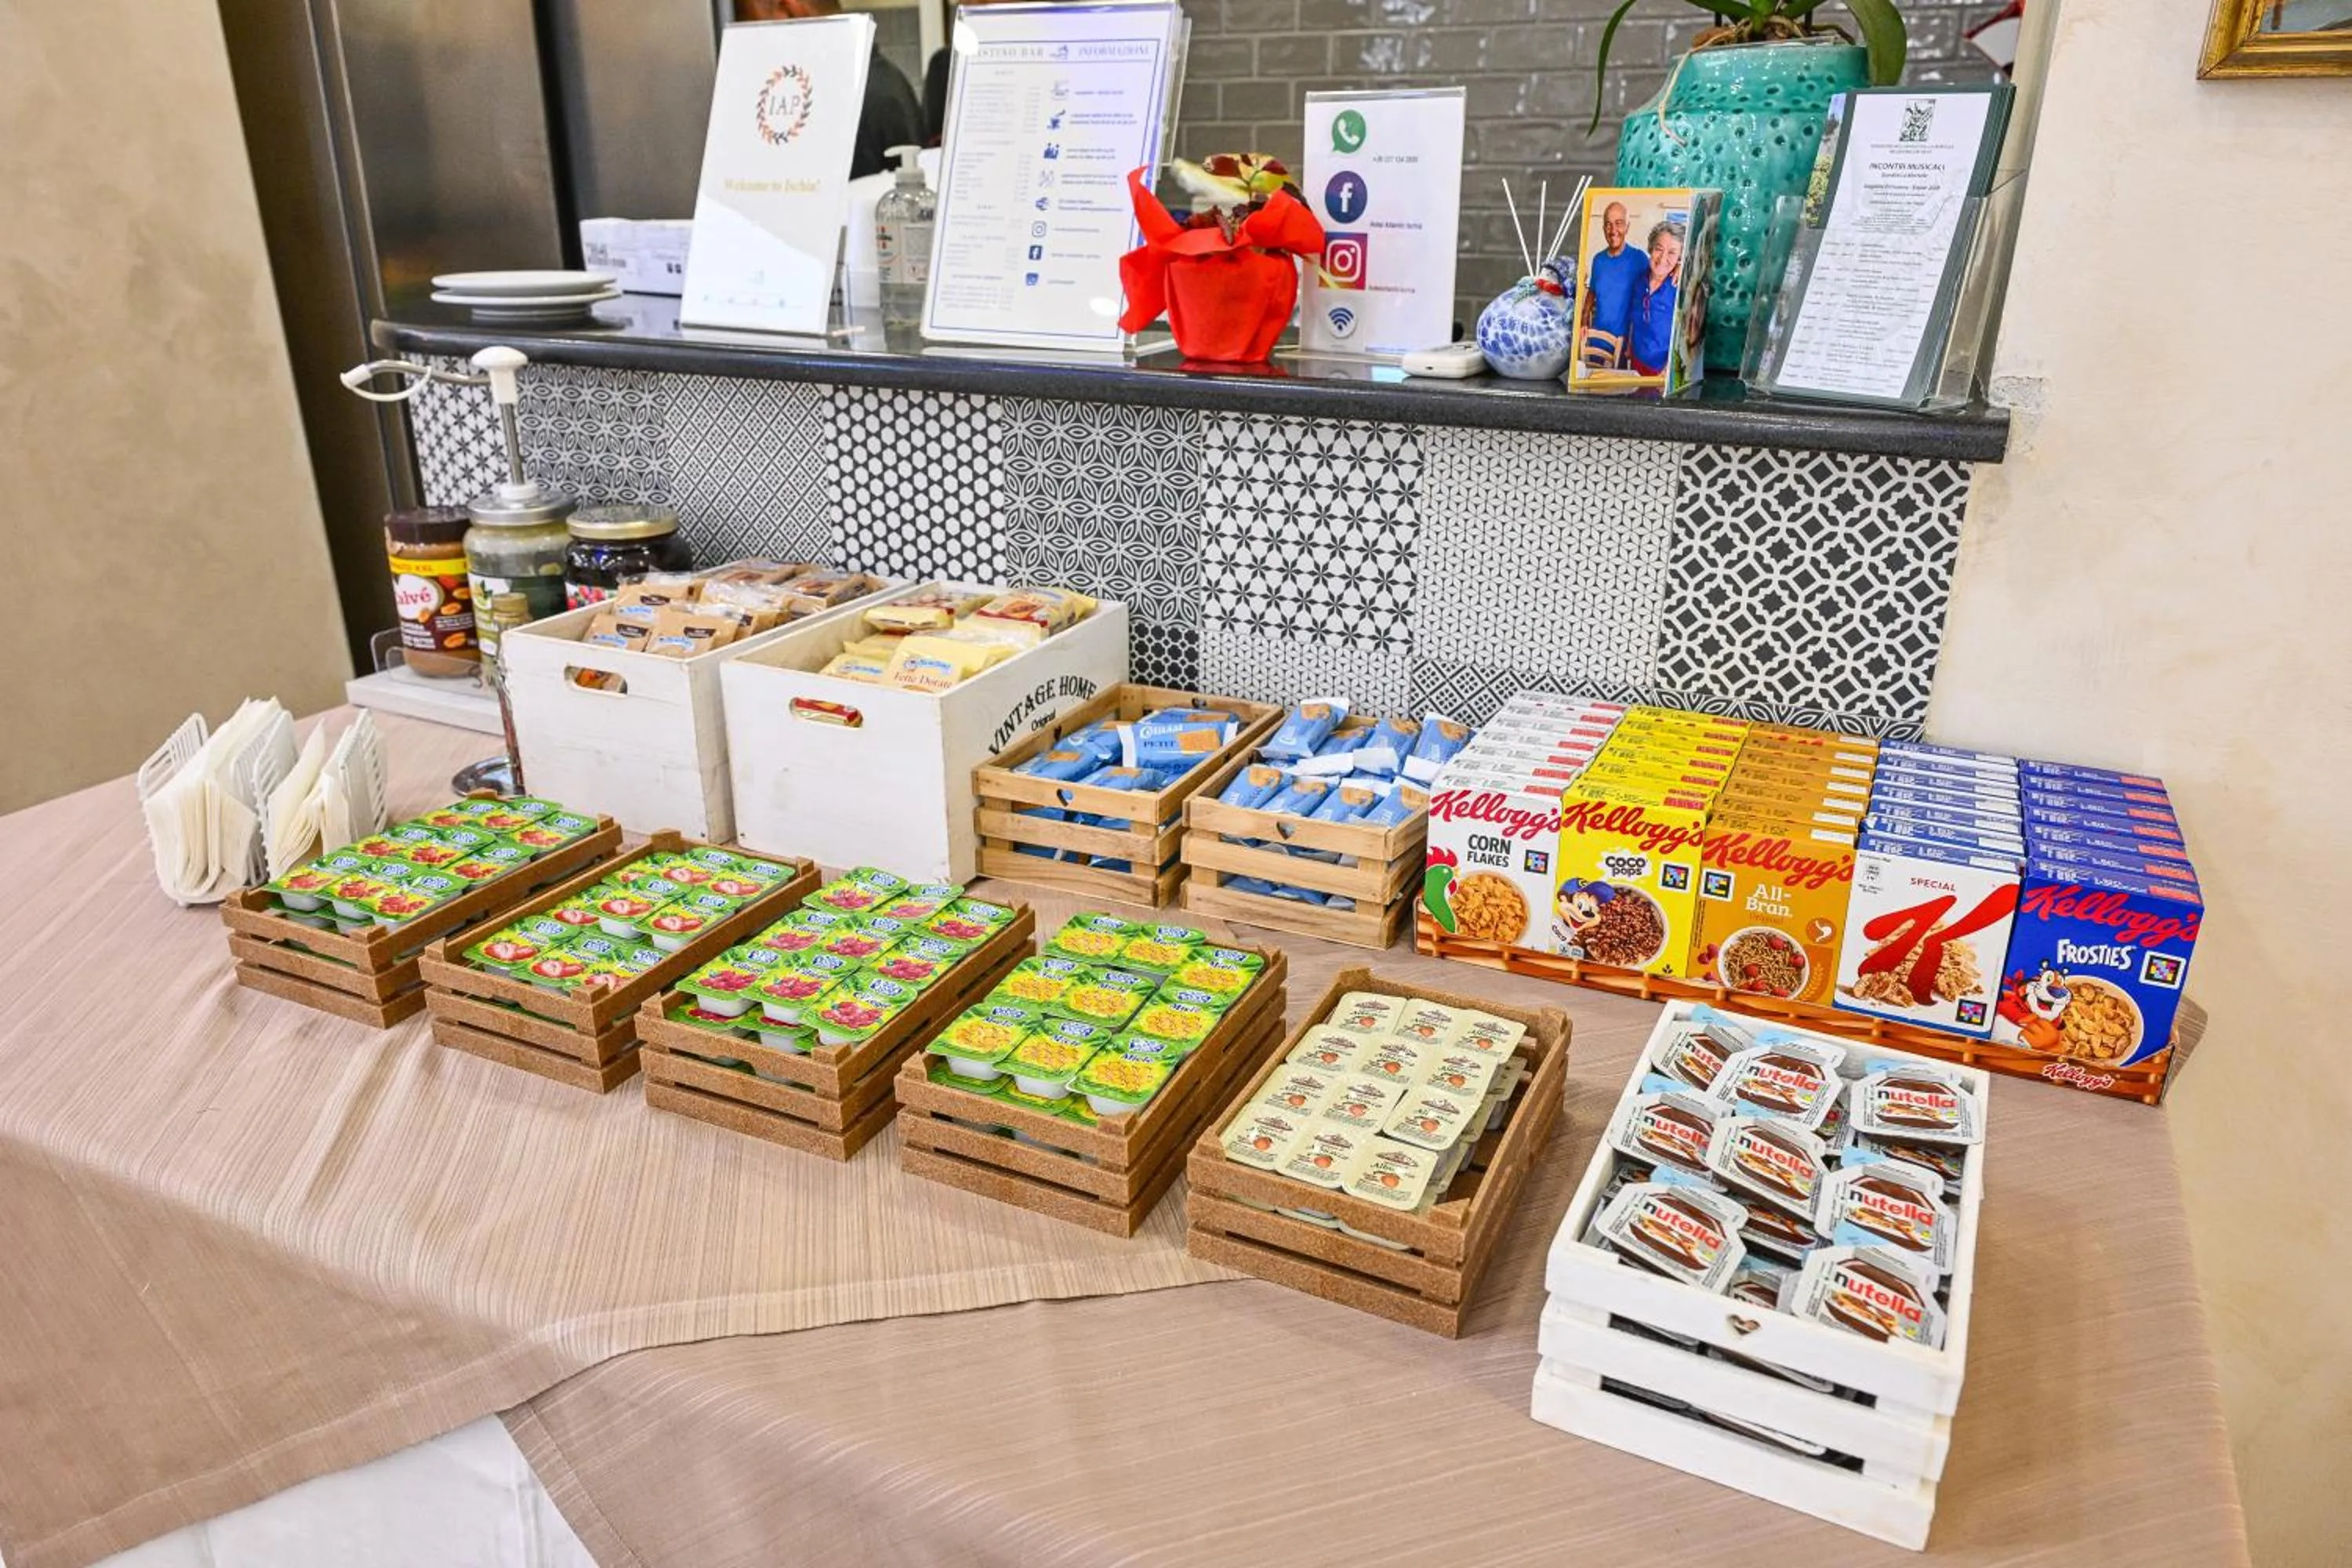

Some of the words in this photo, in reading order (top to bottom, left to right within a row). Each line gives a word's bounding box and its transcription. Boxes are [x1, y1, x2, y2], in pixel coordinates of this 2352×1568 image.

[768, 95, 801, 116] IAP
[989, 679, 1056, 755] VINTAGE
[1059, 675, 1097, 700] HOME
[1031, 707, 1056, 731] Original
[1430, 789, 1561, 840] Kellogg's
[1562, 801, 1704, 855] Kellogg's
[1467, 851, 1509, 868] FLAKES
[1468, 834, 1512, 855] CORN
[1703, 833, 1854, 890] Kellogg's
[1751, 884, 1791, 902] All-
[1911, 877, 1956, 892] SPECIAL
[1744, 896, 1790, 917] Bran
[2021, 884, 2201, 948] Kellogg's
[1858, 884, 2020, 1006] K
[2057, 939, 2132, 970] FROSTIES
[1685, 1040, 1722, 1073] nute
[1748, 1065, 1820, 1093] nutella
[2042, 1064, 2114, 1090] Kellogg's
[1878, 1087, 1957, 1109] nutella
[1738, 1134, 1815, 1178] nutella
[1849, 1188, 1934, 1227] nutella
[1642, 1200, 1722, 1250] nutella
[1834, 1270, 1923, 1324] nutella
